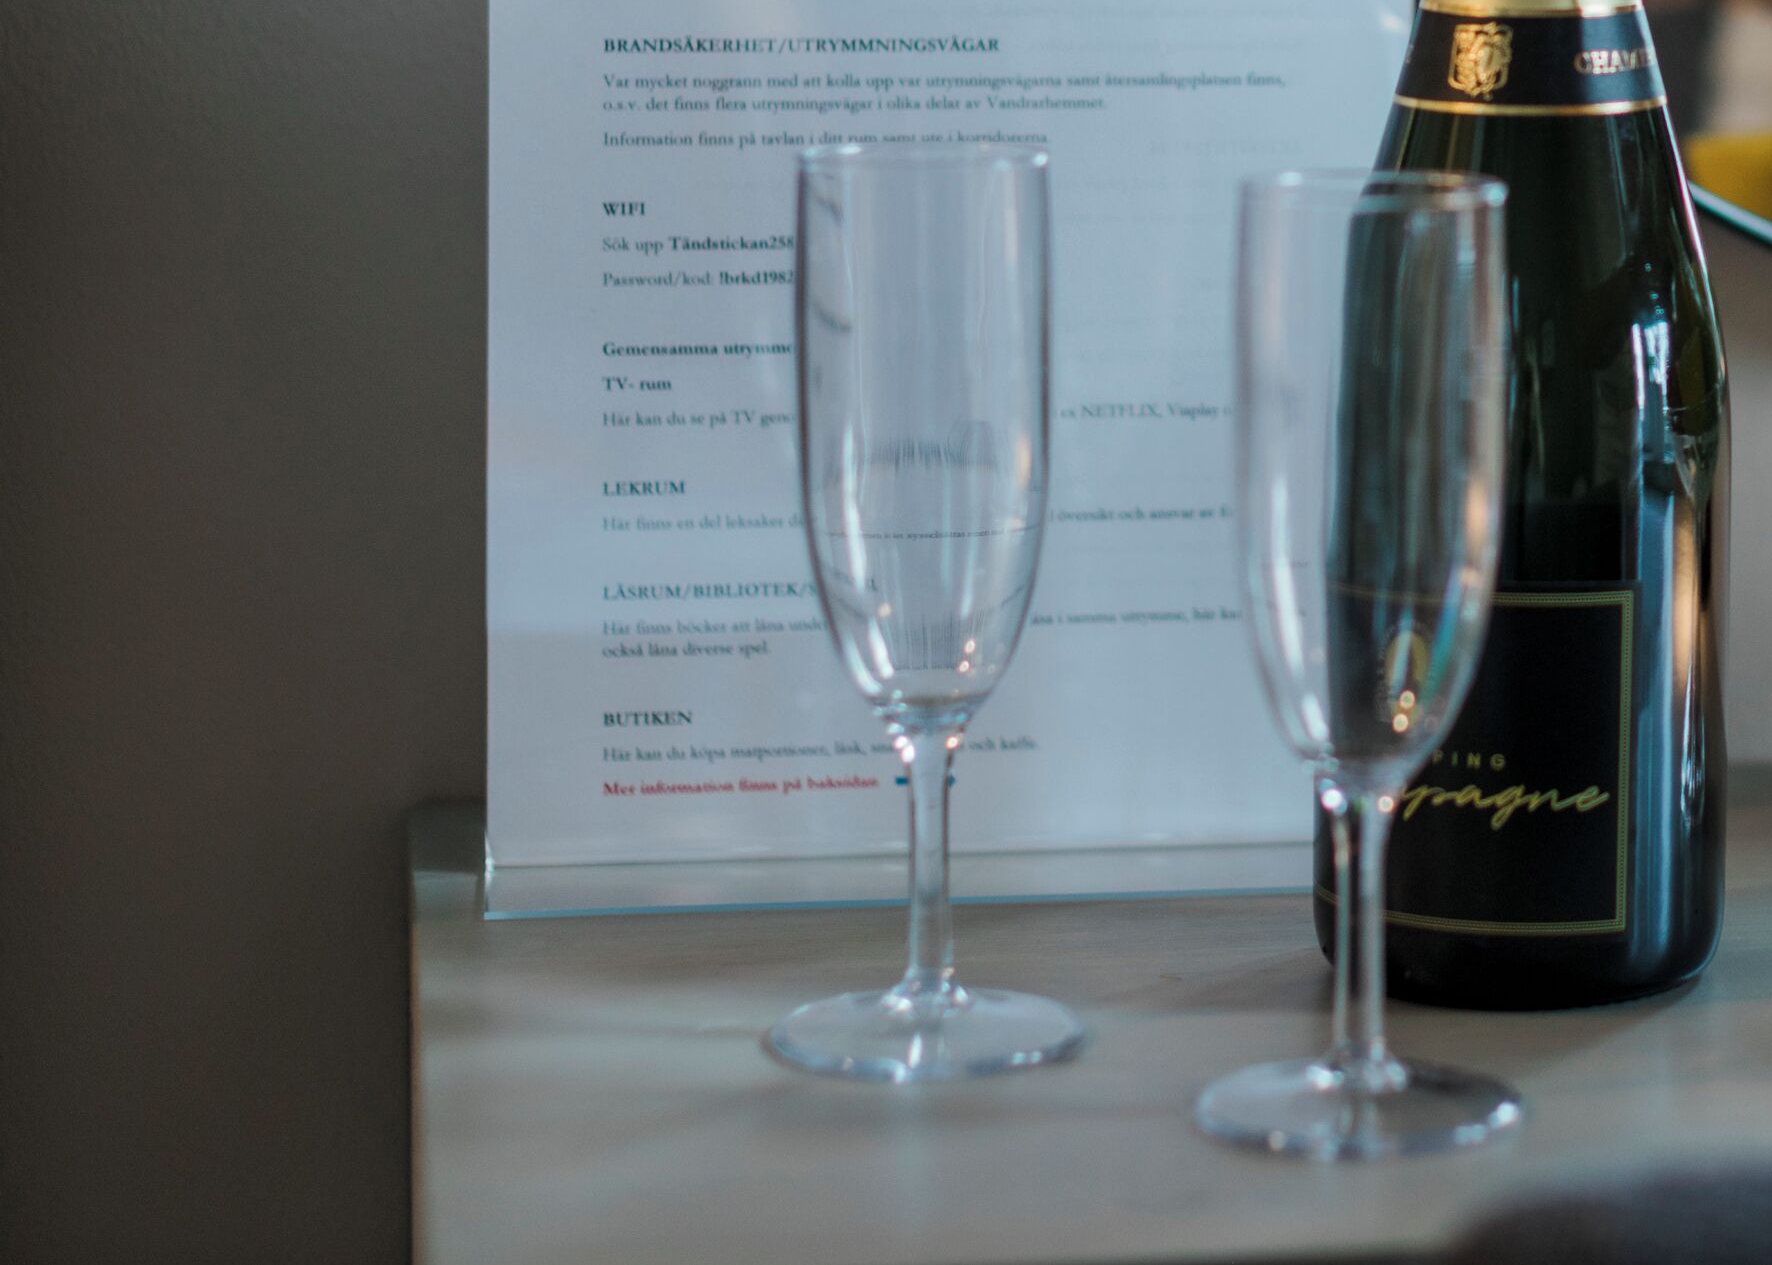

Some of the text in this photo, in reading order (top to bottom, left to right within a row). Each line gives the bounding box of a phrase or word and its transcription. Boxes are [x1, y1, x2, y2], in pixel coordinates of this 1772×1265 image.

[604, 36, 1000, 54] BRANDSÄKERHET/UTRYMMNINGSVÄGAR
[604, 74, 629, 88] Var
[635, 74, 687, 92] mycket
[693, 78, 761, 93] noggrann
[767, 74, 797, 88] med
[804, 75, 820, 88] att
[827, 74, 860, 88] kolla
[866, 78, 893, 92] upp
[900, 78, 920, 88] var
[1067, 75, 1100, 87] samt
[1247, 71, 1286, 88] finns,
[603, 100, 641, 111] o.s.v.
[646, 97, 668, 111] det
[674, 97, 709, 111] finns
[716, 96, 746, 111] flera
[753, 98, 872, 115] utrymningsvägar
[886, 96, 920, 110] olika
[926, 95, 960, 110] delar
[966, 99, 981, 110] av
[604, 131, 693, 147] Information
[698, 131, 734, 146] finns
[740, 130, 756, 149] på
[762, 130, 804, 145] tavlan
[819, 130, 843, 144] ditt
[603, 201, 646, 217] WIFI
[602, 237, 629, 251] Sök
[635, 241, 663, 256] upp
[602, 341, 718, 356] Gemensamma
[639, 378, 672, 391] rum
[603, 410, 793, 428] Här kan du se på TV geno
[603, 480, 685, 496] LEKRUM
[603, 516, 630, 530] Här
[637, 515, 672, 530] finns
[677, 519, 695, 529] en
[700, 514, 721, 529] del
[603, 581, 817, 601] LÄSRUM/BIBLIOTEK/S
[603, 620, 630, 635] Här
[637, 619, 672, 634] finns
[732, 622, 750, 633] att
[602, 641, 643, 658] också
[648, 640, 677, 656] låna
[683, 639, 733, 655] diverse
[603, 710, 693, 727] BUTIKEN
[604, 746, 631, 762] Här
[636, 745, 662, 761] kan
[667, 745, 686, 760] du
[603, 781, 635, 797] Mer
[641, 777, 734, 795] information
[1401, 784, 1610, 830] pagne
